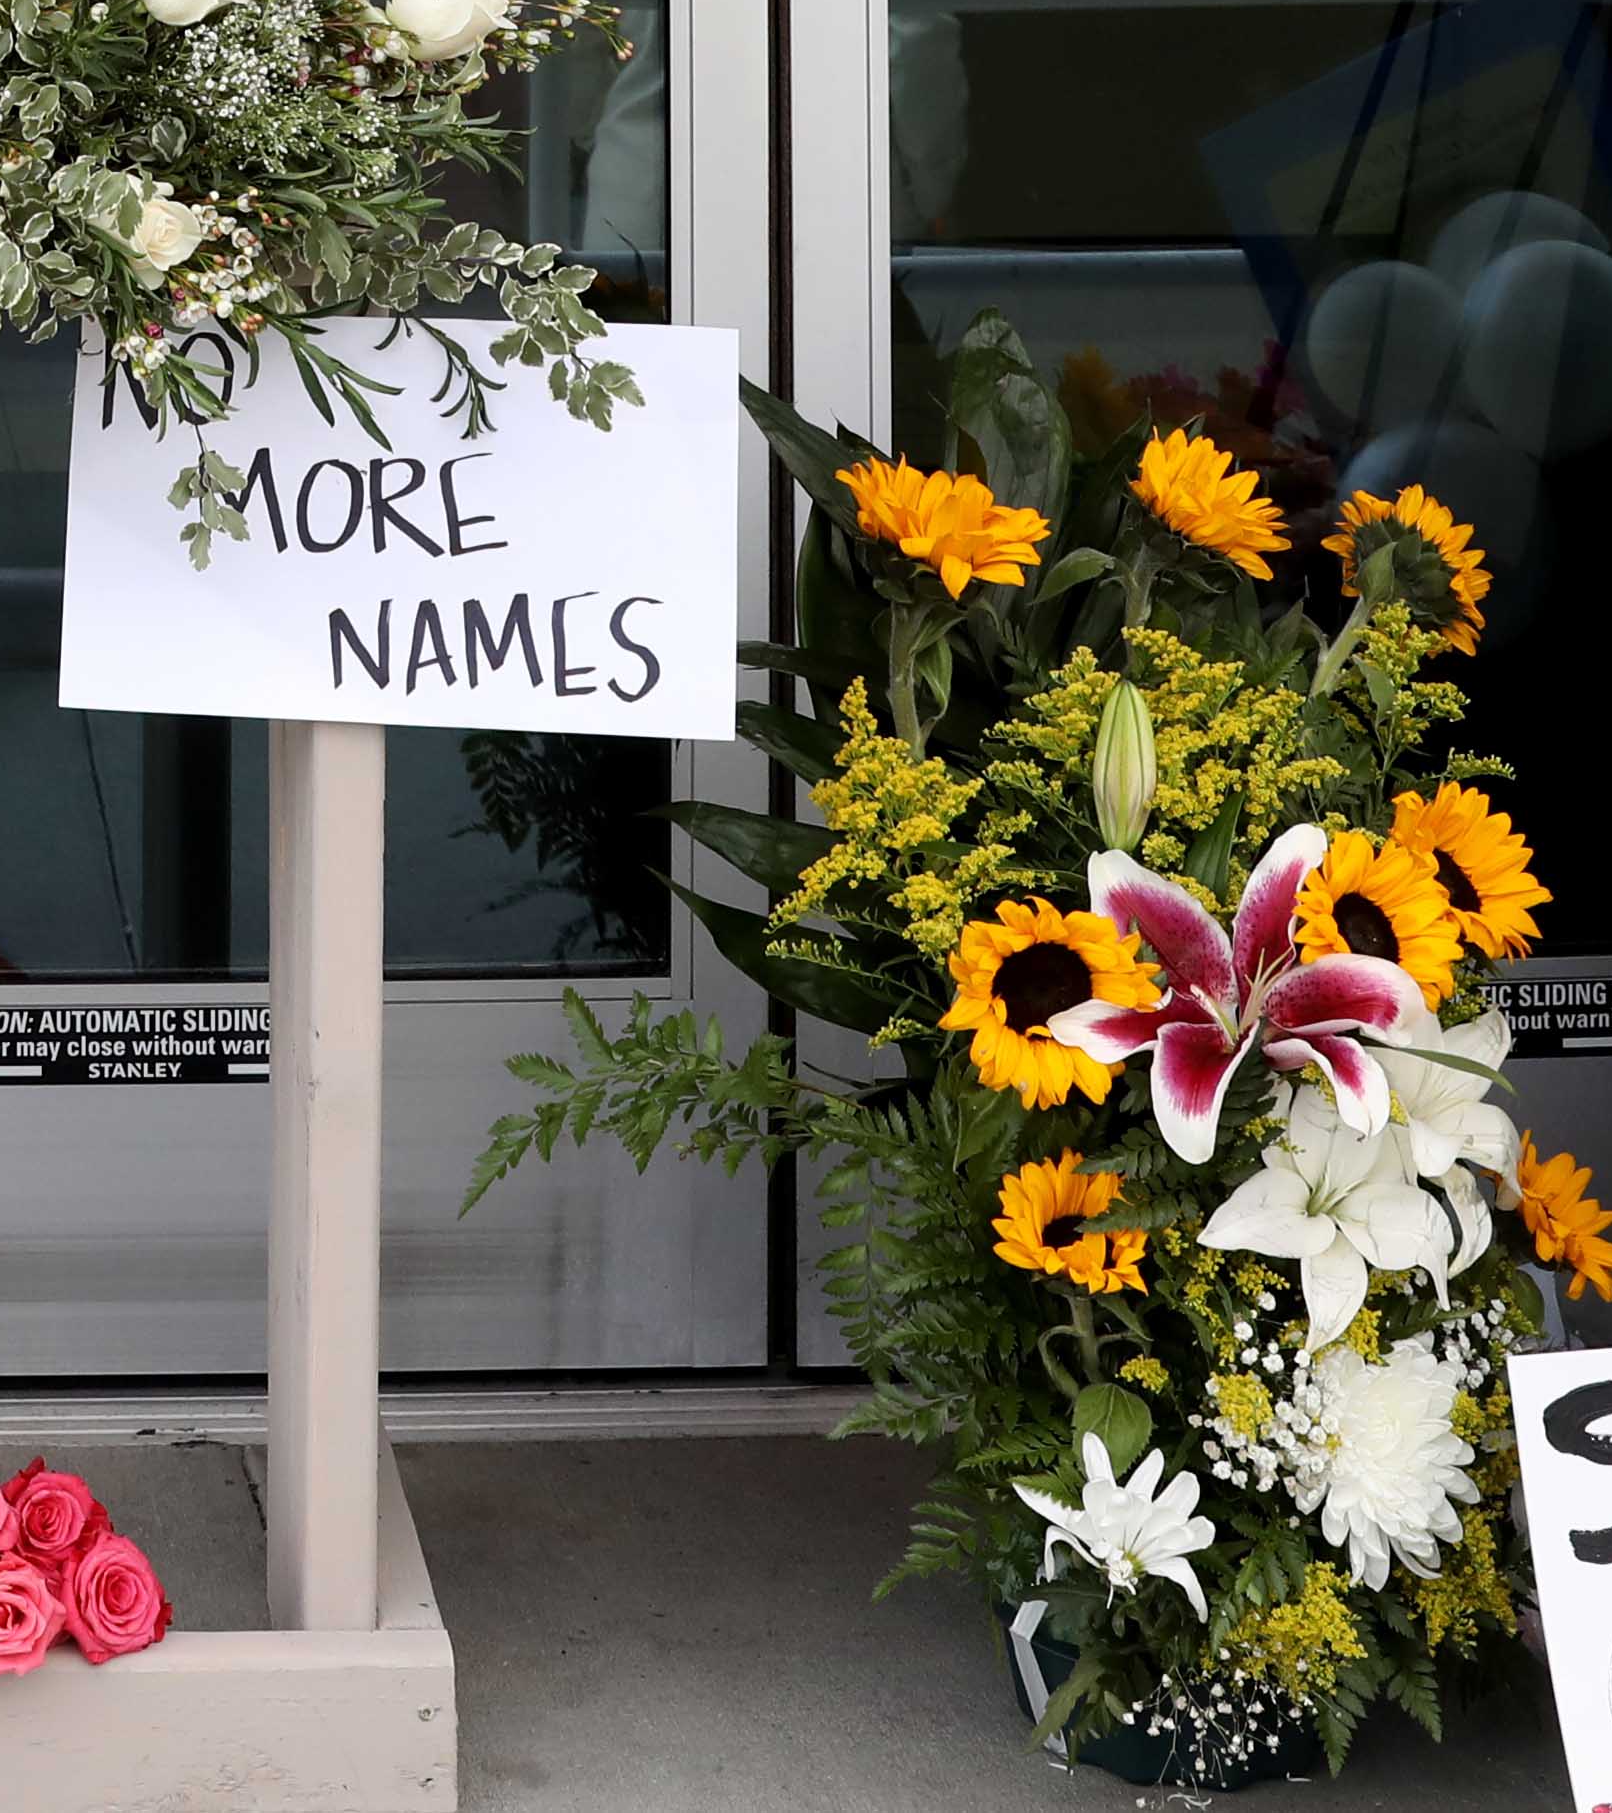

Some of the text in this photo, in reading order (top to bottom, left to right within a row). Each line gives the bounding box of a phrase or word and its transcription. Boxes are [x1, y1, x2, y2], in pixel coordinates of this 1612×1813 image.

[102, 314, 234, 430] NO
[200, 447, 509, 557] MORE
[328, 590, 665, 703] NAMES
[1518, 982, 1607, 1007] SLIDING
[39, 1009, 177, 1034] AUTOMATIC
[182, 1008, 270, 1033] SLIDING
[16, 1039, 61, 1062] may
[67, 1036, 126, 1057] close
[132, 1036, 217, 1057] without
[88, 1062, 182, 1079] STANLEY
